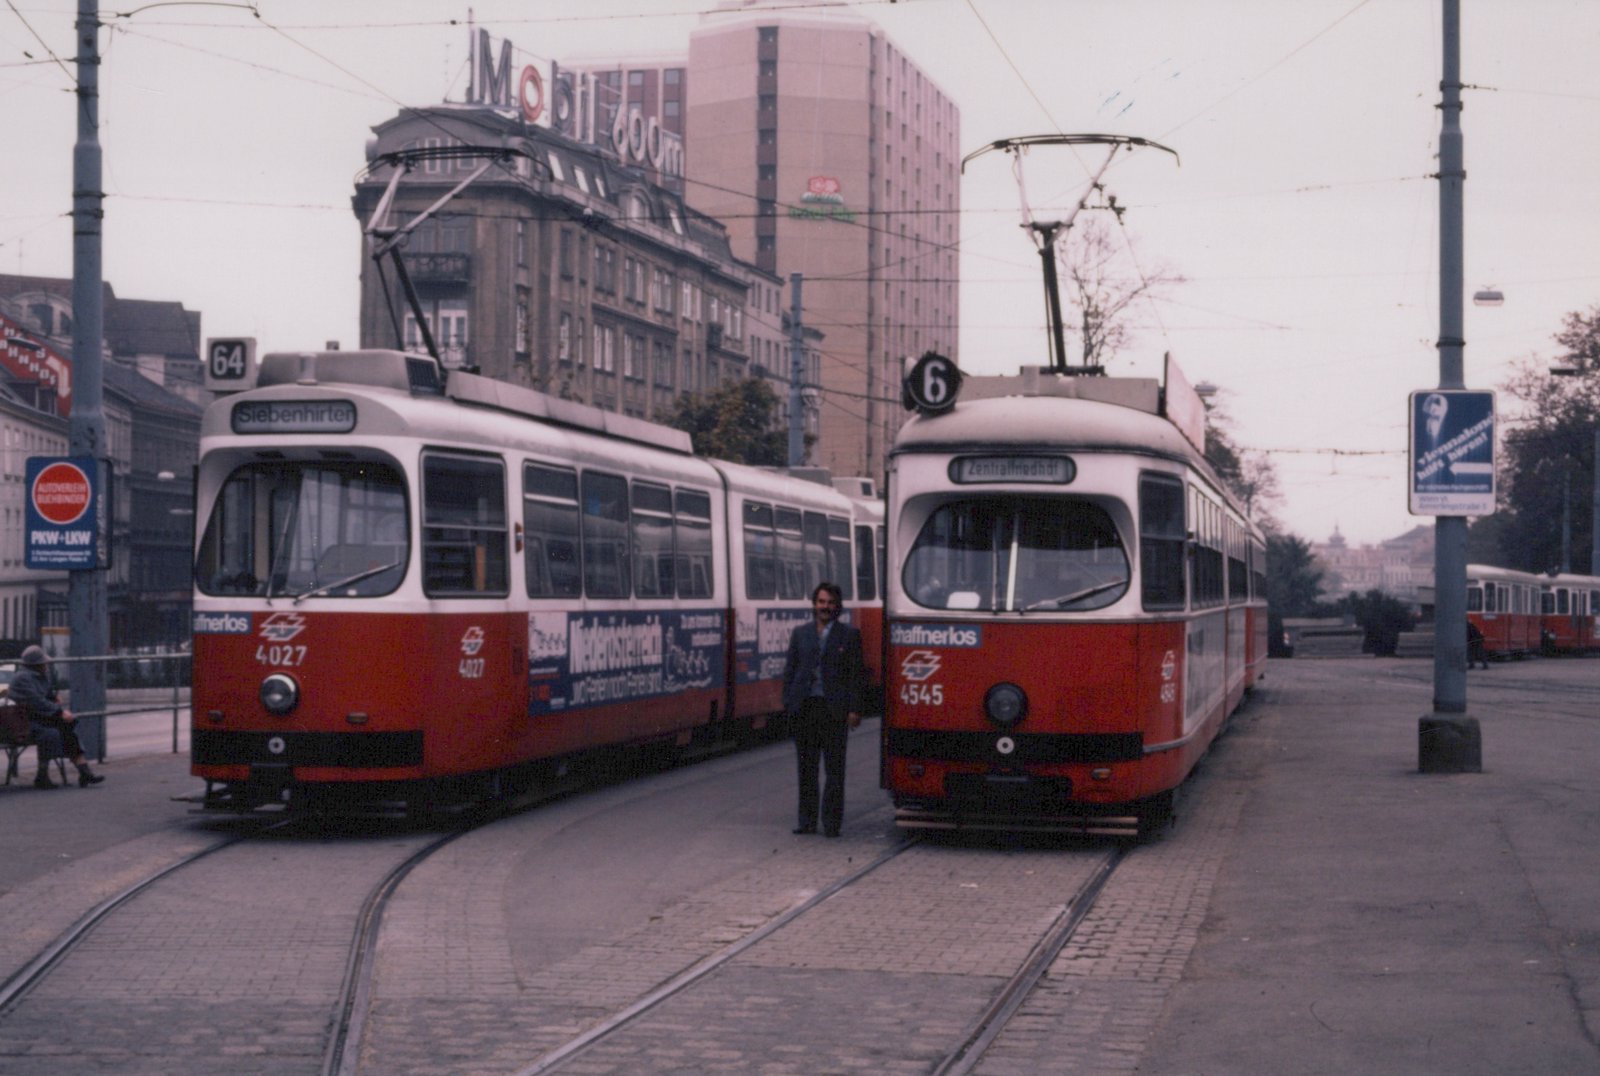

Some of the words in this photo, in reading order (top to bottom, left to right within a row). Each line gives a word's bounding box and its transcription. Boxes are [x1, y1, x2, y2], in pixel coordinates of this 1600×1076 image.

[471, 27, 600, 146] Mobil
[213, 345, 245, 376] 64
[923, 360, 947, 403] 6
[968, 459, 1060, 477] Zentralfriedhof
[254, 644, 307, 667] 4027
[569, 614, 663, 675] Niederösterreich
[458, 657, 485, 679] 4027
[900, 683, 944, 706] 4545
